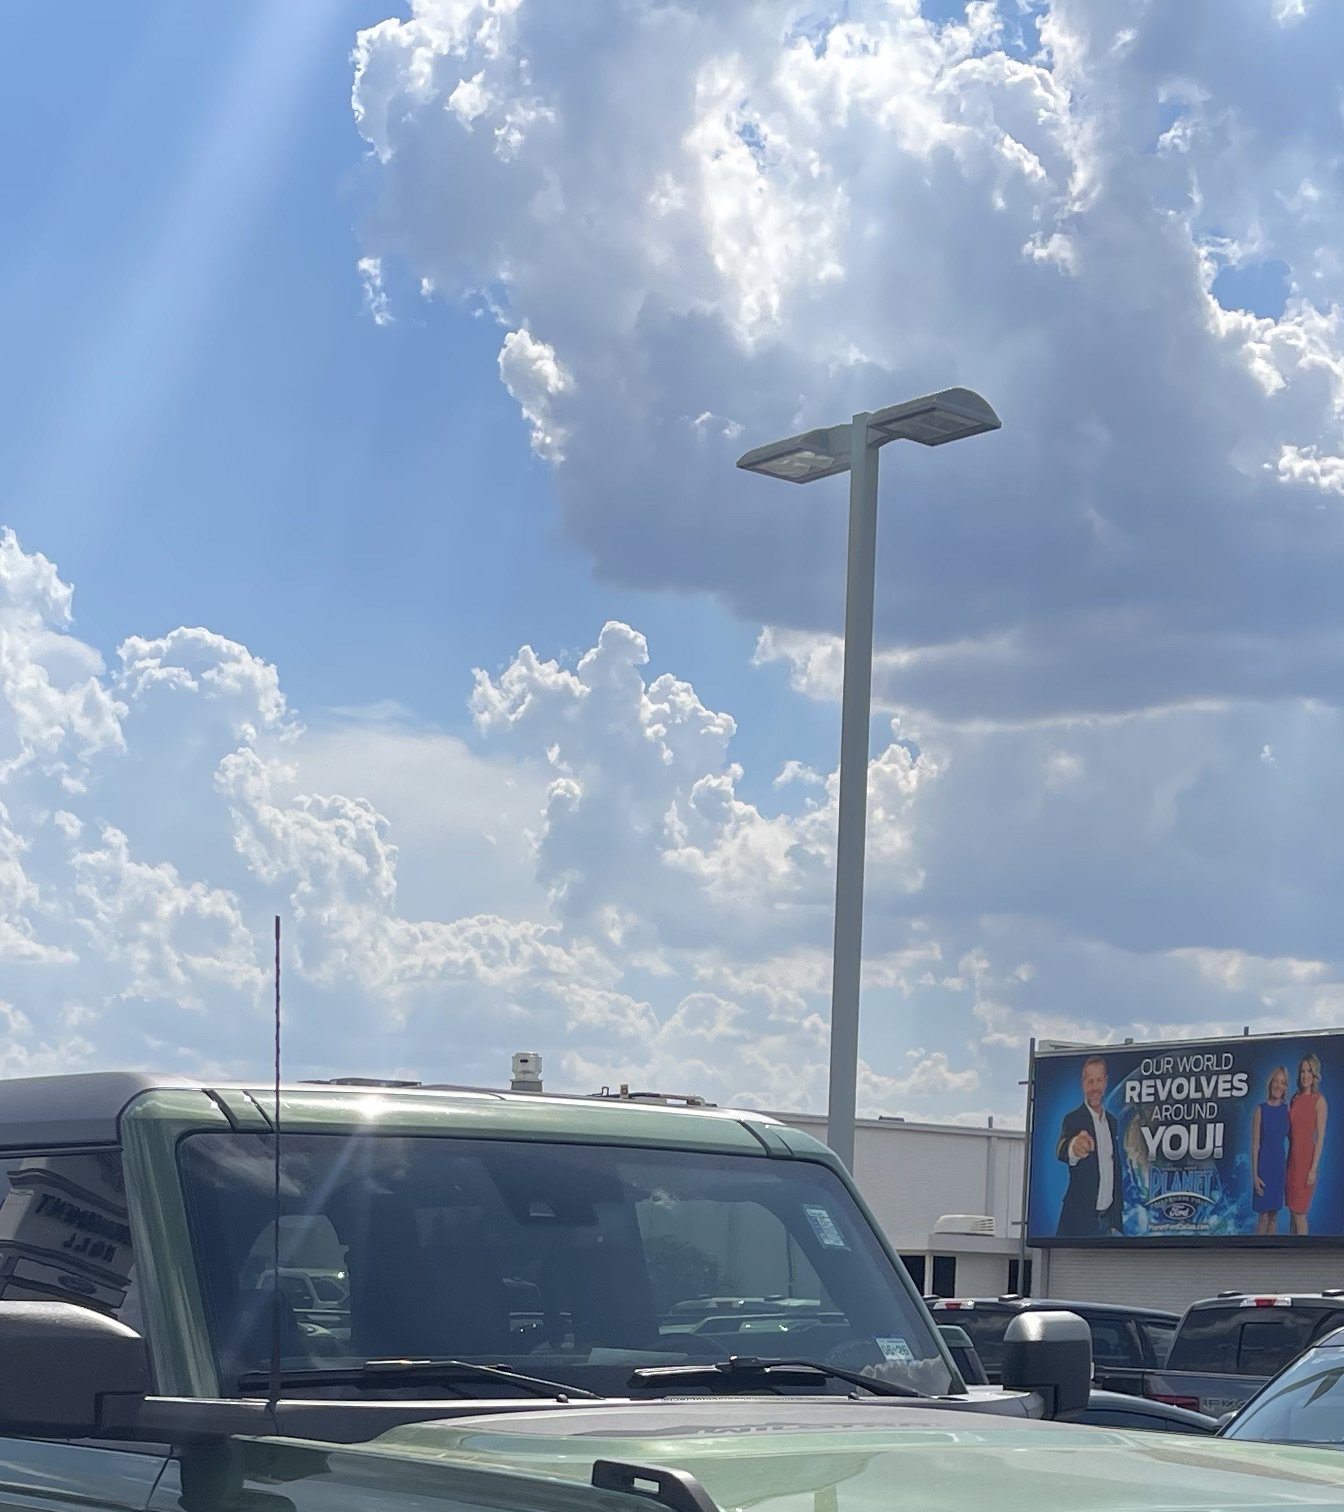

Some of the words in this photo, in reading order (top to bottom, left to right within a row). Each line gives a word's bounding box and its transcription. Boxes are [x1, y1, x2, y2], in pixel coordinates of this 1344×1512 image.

[1140, 1057, 1174, 1076] OUR
[1177, 1052, 1233, 1073] WORLD
[1125, 1072, 1249, 1103] REVOLVES
[1151, 1101, 1218, 1121] AROUND
[1140, 1122, 1224, 1161] YOU!
